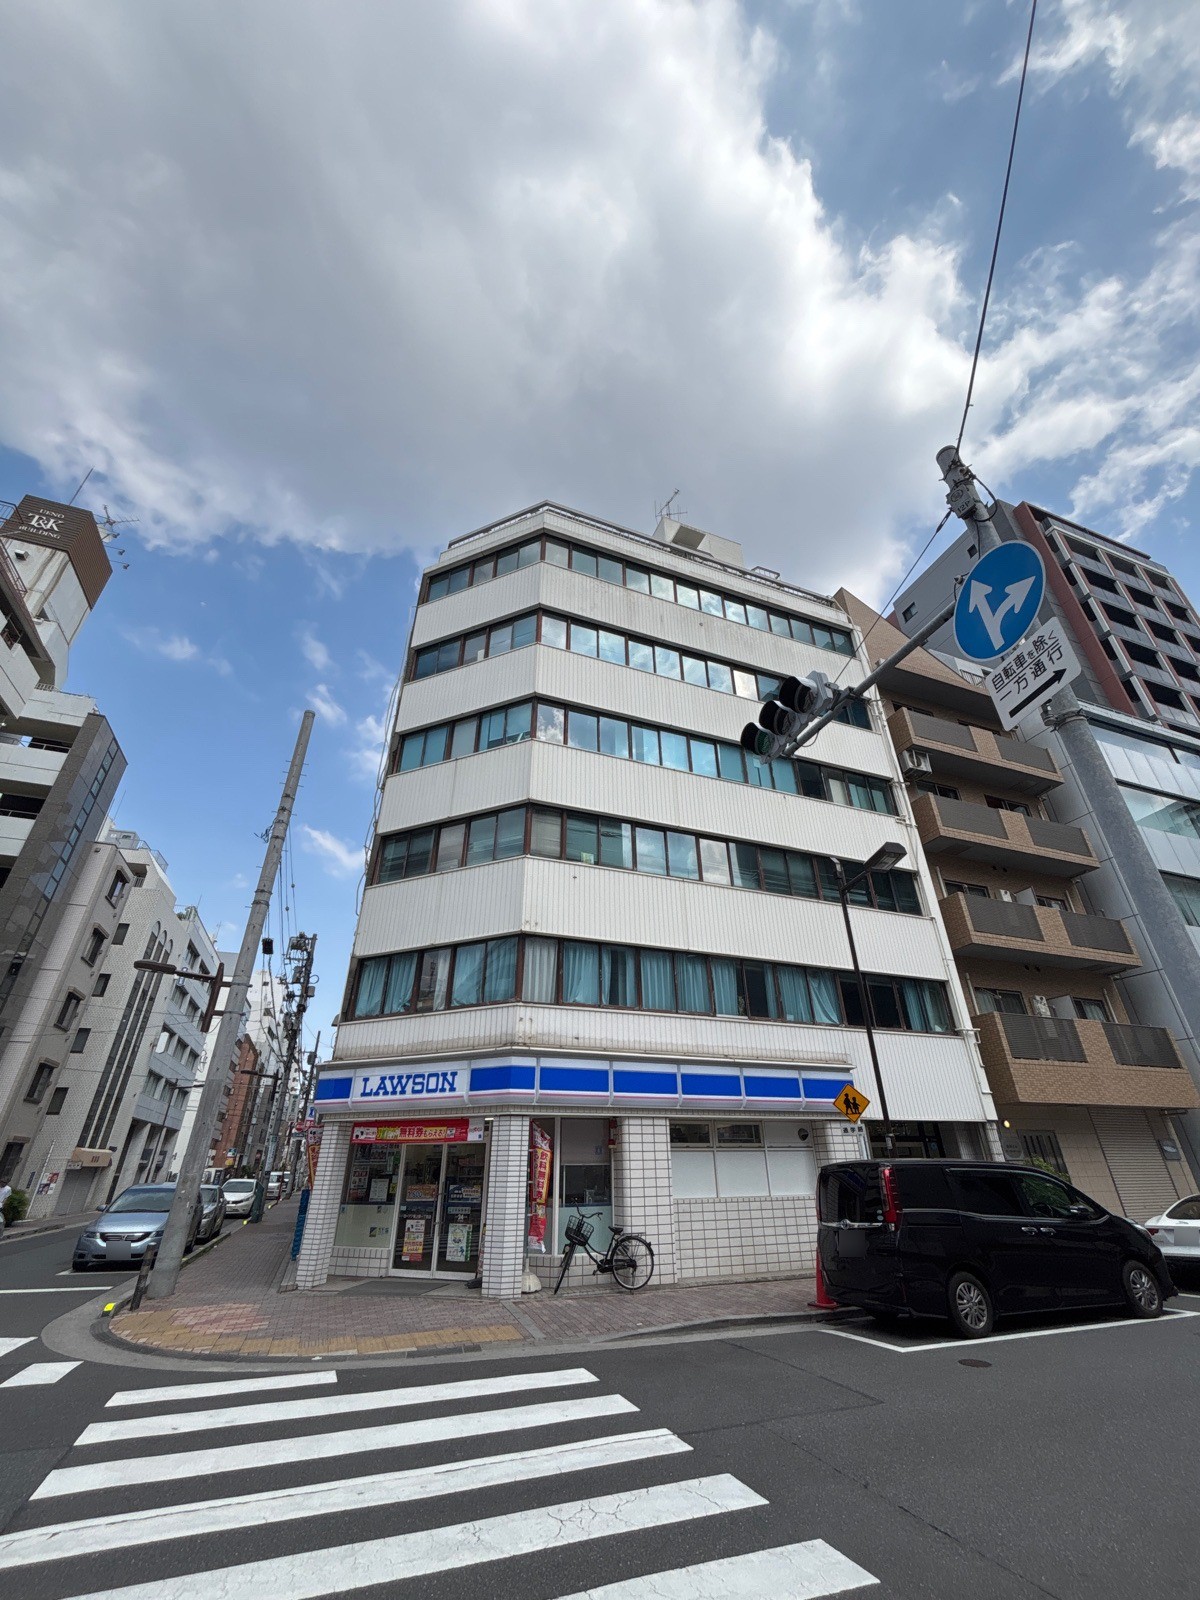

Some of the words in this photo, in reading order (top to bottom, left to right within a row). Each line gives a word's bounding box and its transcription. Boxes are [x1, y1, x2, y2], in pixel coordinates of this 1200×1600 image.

[28, 513, 64, 531] T&K
[40, 509, 64, 519] UENO
[19, 525, 60, 539] BUILDING
[992, 630, 1056, 690] 自転車を除く
[1000, 643, 1063, 701] 一方通行
[360, 1071, 458, 1097] LAWSON
[843, 1126, 863, 1134] 通学路
